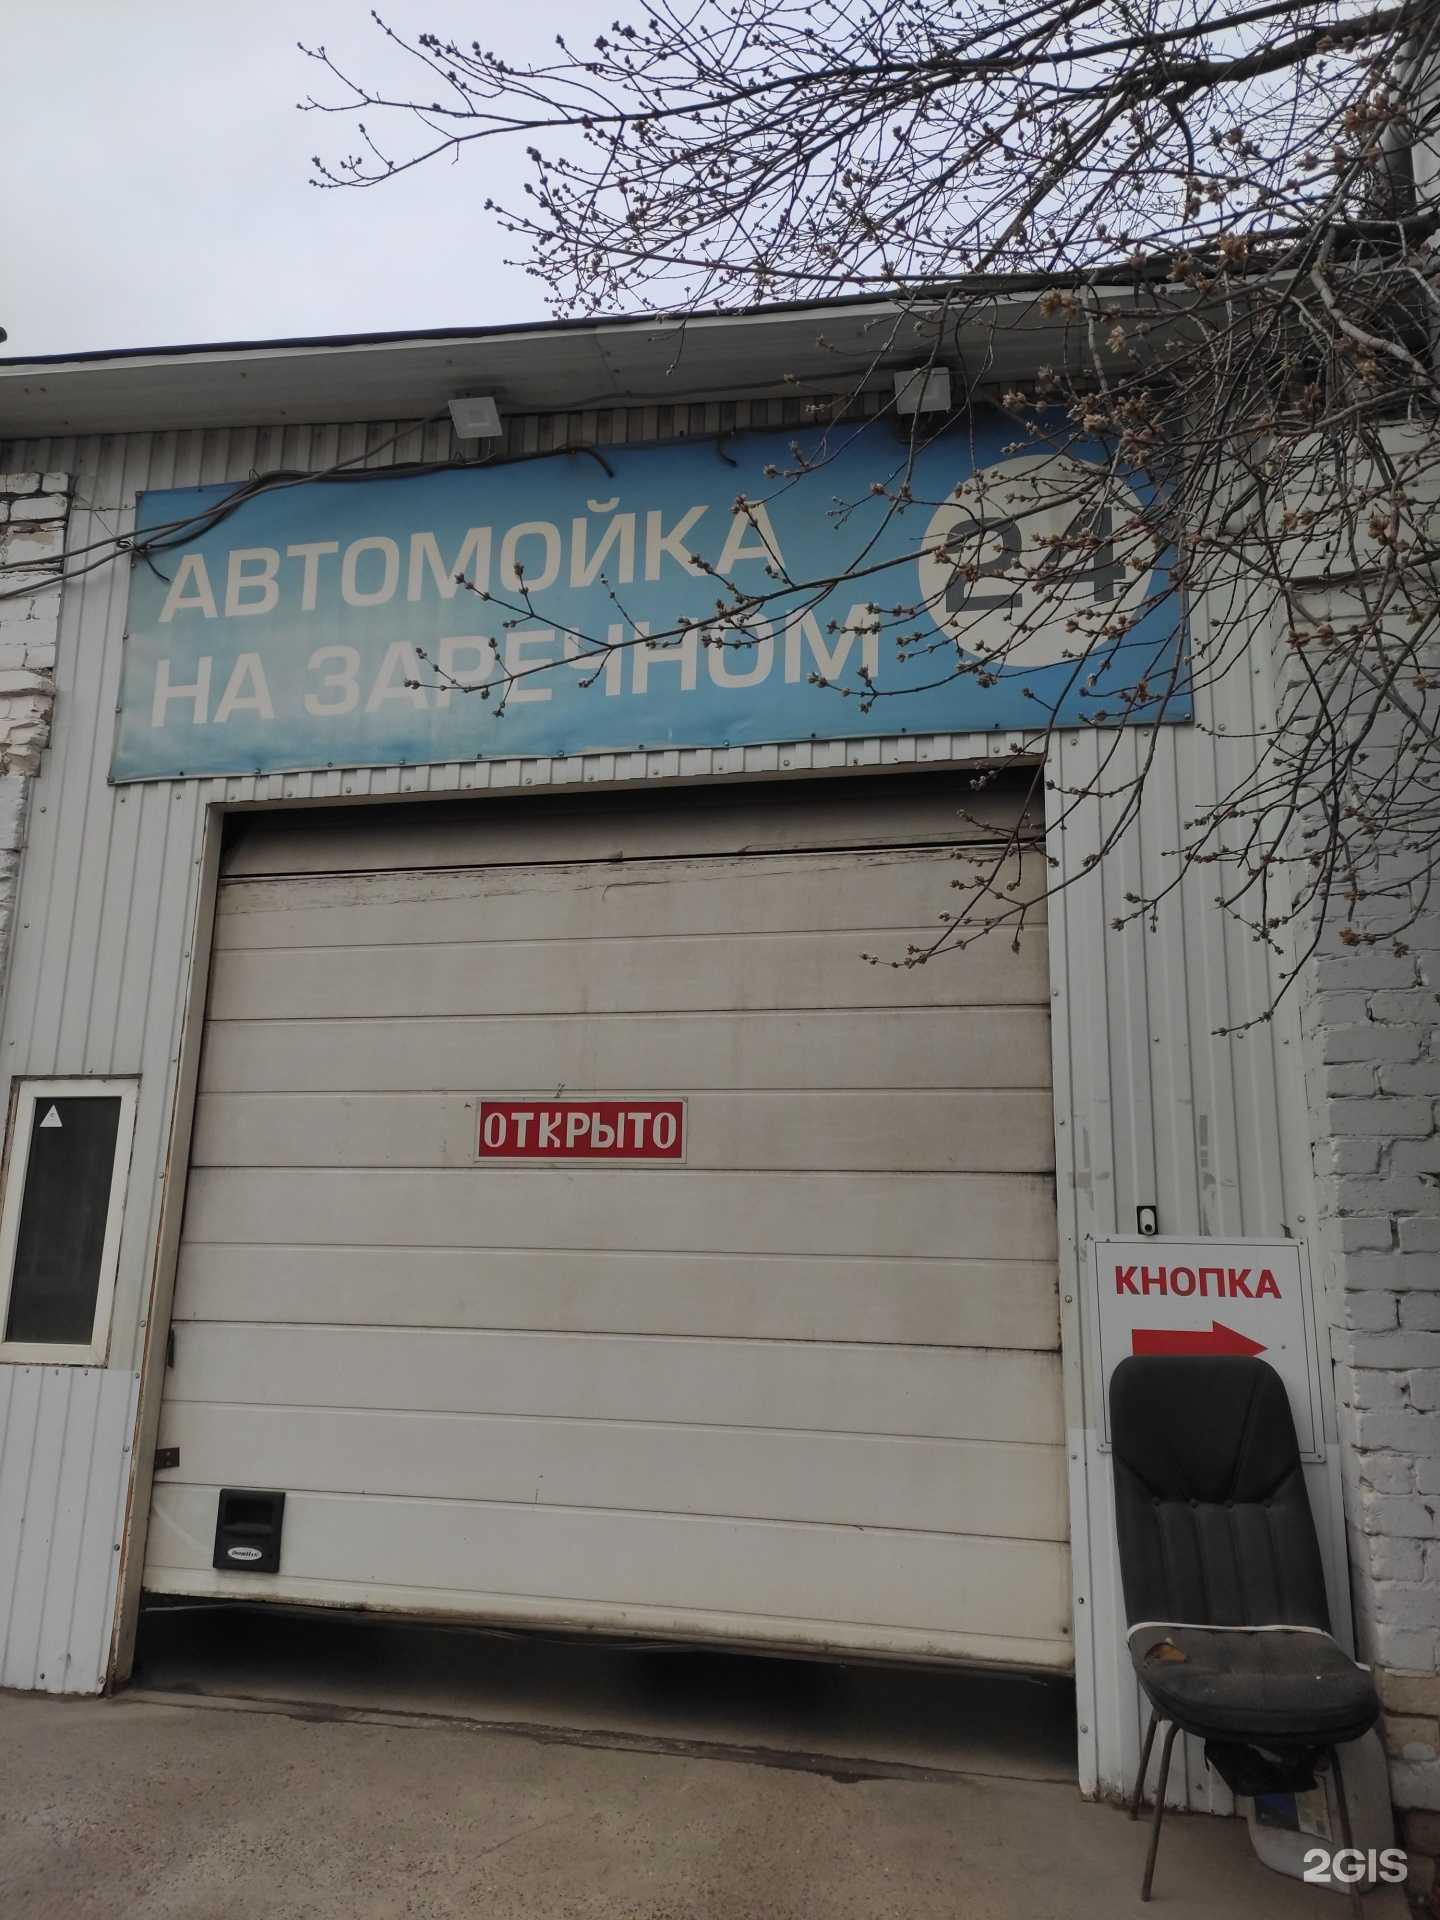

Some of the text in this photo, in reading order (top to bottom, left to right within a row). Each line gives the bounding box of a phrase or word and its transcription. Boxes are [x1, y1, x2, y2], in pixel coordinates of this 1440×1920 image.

[157, 497, 786, 623] АВТОМОЙКА
[946, 507, 1126, 613] 24
[151, 603, 880, 727] НА ЗАРЕЧНОМ
[484, 1112, 677, 1149] ОТКРЫТО
[1115, 1265, 1282, 1299] КНОПКА
